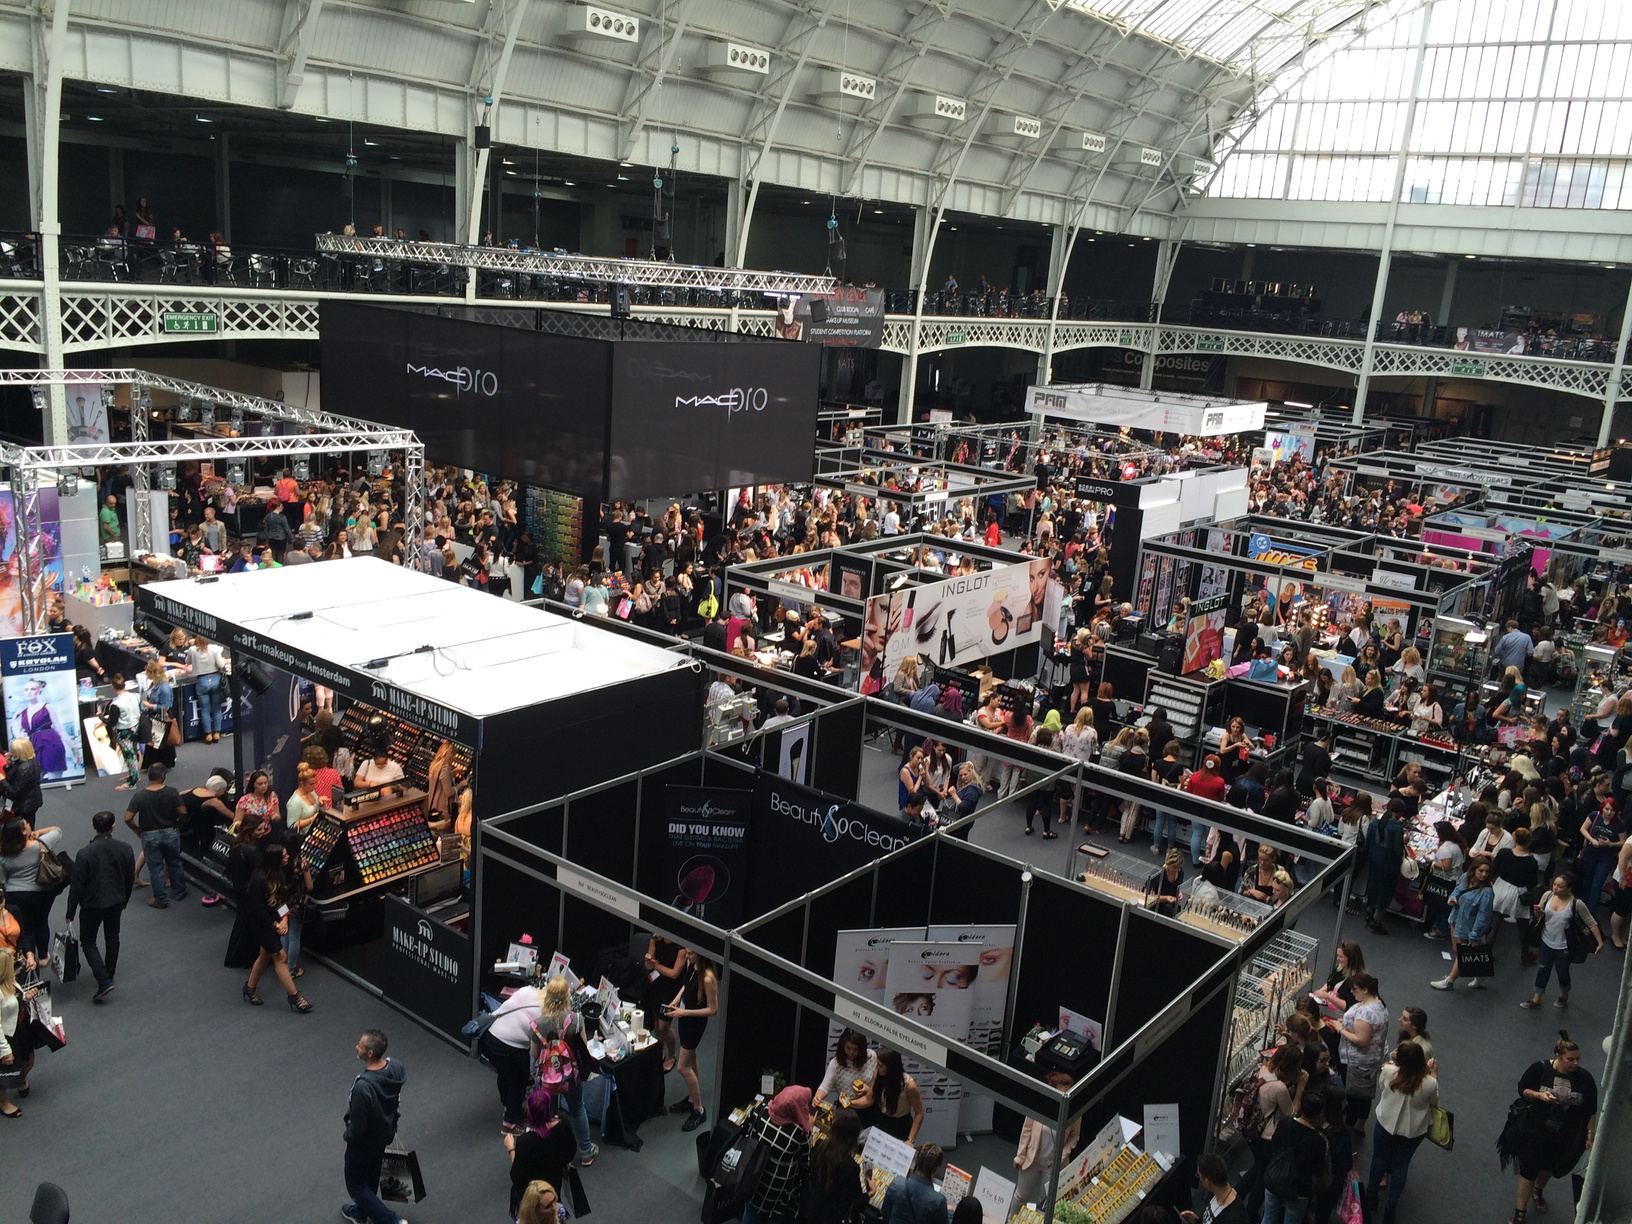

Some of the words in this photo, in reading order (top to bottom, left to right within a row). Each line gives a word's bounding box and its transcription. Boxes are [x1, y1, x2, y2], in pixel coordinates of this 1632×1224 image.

[828, 328, 853, 336] COMPETITION
[1124, 351, 1210, 373] Coposites
[1445, 470, 1460, 479] BEST
[1095, 486, 1114, 496] PRO
[942, 575, 991, 598] INGLOT
[1195, 596, 1225, 614] INGLOT
[194, 610, 217, 632] STUDIO
[16, 638, 57, 655] FOX
[18, 656, 68, 666] KRYOLAN
[233, 634, 241, 643] the
[241, 633, 258, 650] art
[262, 643, 295, 666] makeup
[295, 658, 307, 669] from
[307, 661, 351, 687] Amsterdam
[23, 665, 56, 673] LONDON
[389, 687, 427, 716] MAKE-UP
[427, 703, 458, 730] STUDIO
[668, 823, 687, 834] DID
[688, 824, 710, 836] YOU
[712, 825, 746, 838] KNOW
[1427, 884, 1449, 897] IMATS
[392, 925, 429, 959] MAKE-UP
[429, 946, 459, 977] STUDIO
[392, 941, 430, 969] PROFESSIONAL
[1461, 953, 1490, 963] IMATS
[864, 1016, 883, 1030] ELDORA
[883, 1024, 899, 1038] FALSE
[899, 1032, 928, 1051] EYELASHES
